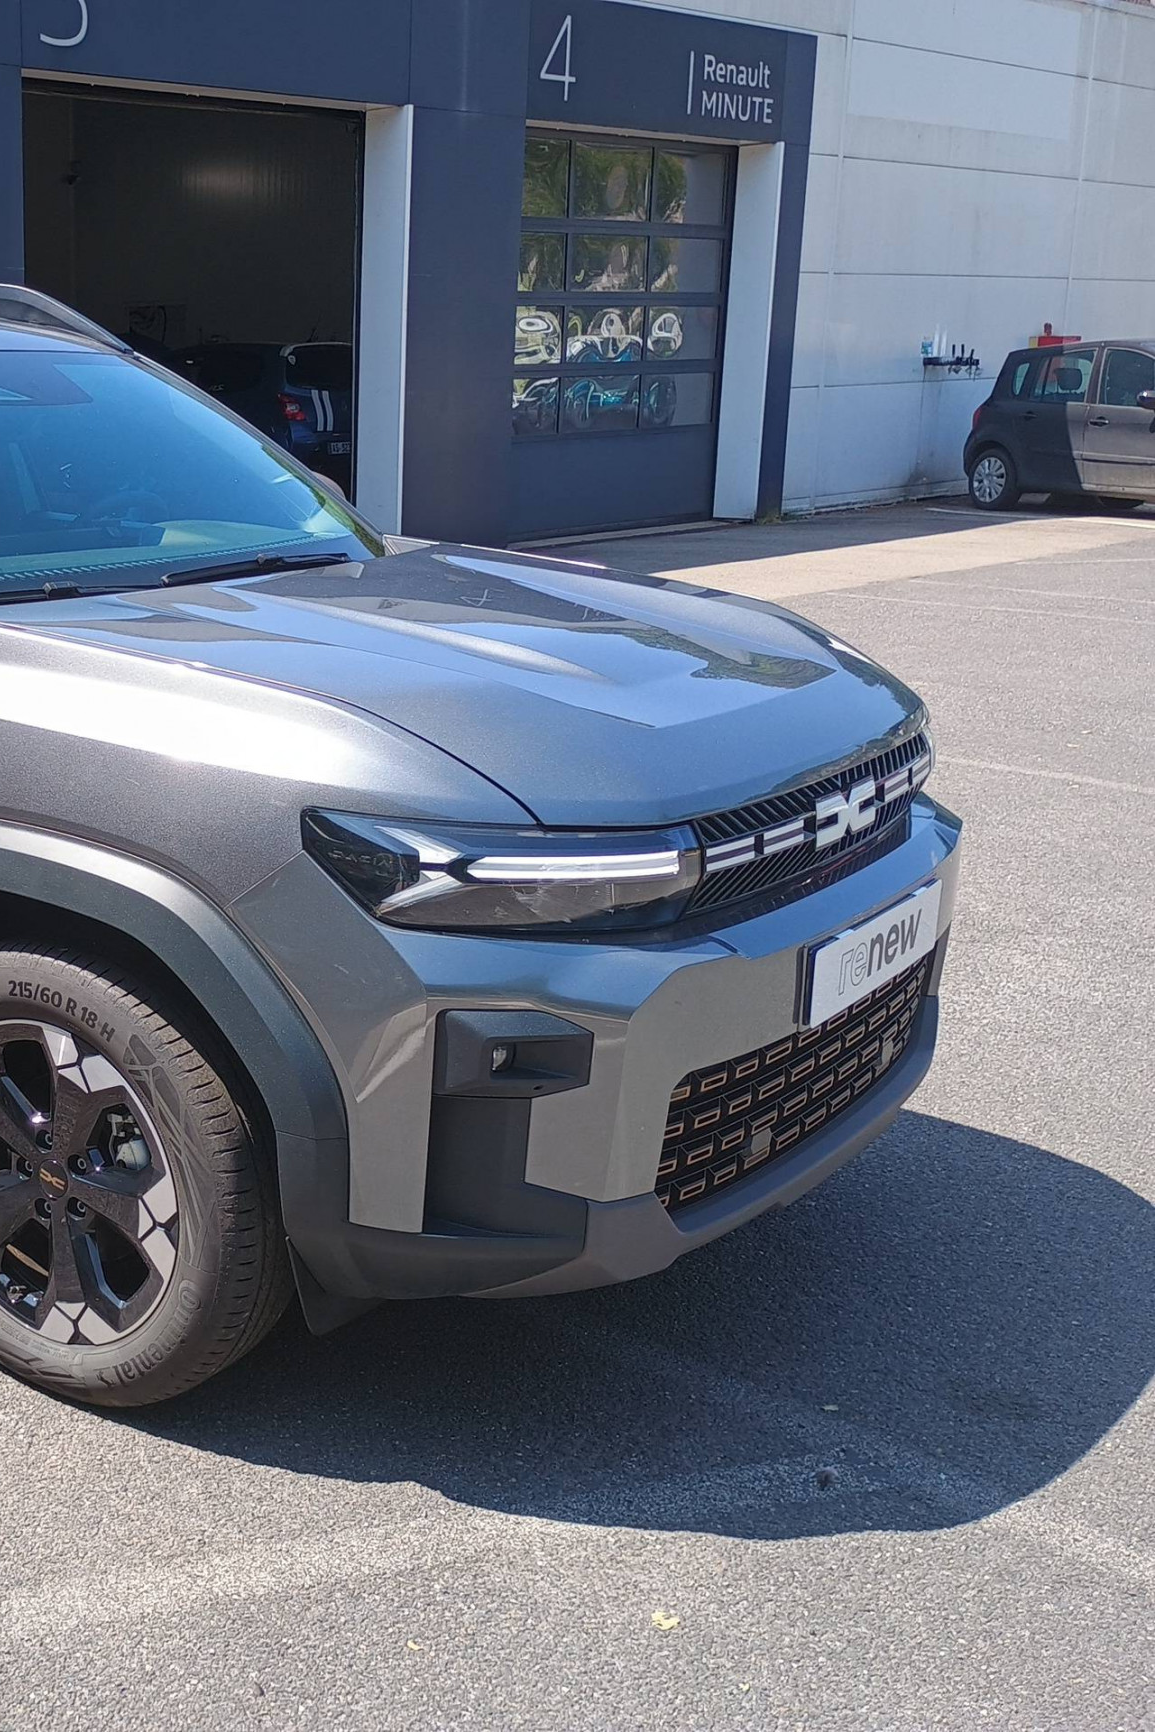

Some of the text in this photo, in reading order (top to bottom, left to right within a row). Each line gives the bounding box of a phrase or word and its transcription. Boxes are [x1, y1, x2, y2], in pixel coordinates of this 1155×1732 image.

[540, 15, 576, 101] 4
[704, 54, 771, 89] Renault
[701, 90, 774, 124] MINUTE
[838, 908, 922, 996] renew
[8, 980, 63, 1008] 215/60
[65, 997, 77, 1017] R
[80, 1006, 98, 1029] 18
[100, 1022, 116, 1042] H
